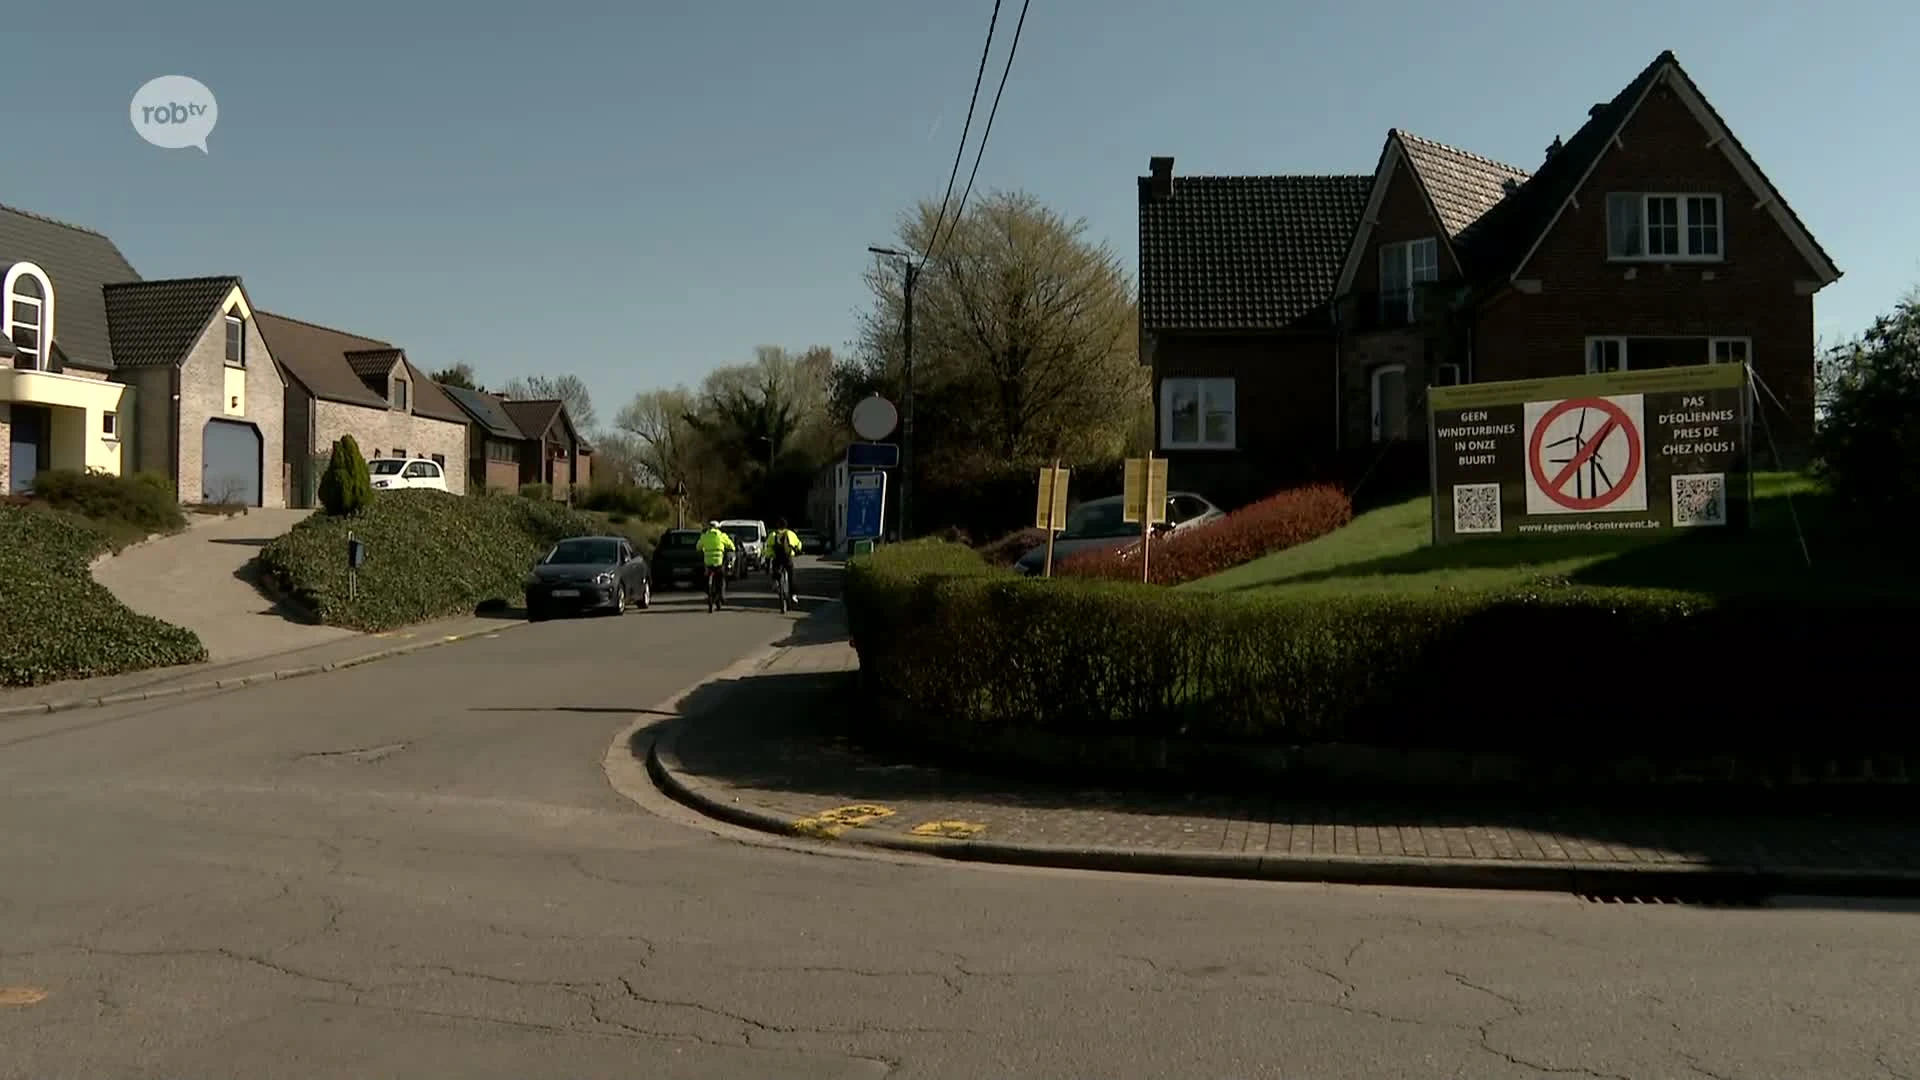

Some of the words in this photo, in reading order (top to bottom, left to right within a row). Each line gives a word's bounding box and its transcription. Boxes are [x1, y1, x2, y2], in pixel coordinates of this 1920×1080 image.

[1682, 396, 1705, 408] PAS
[1460, 411, 1488, 422] GEEN
[1437, 424, 1516, 438] WINDTURBINES
[1673, 427, 1702, 439] PRES
[1703, 426, 1719, 437] DE
[1454, 441, 1466, 451] IN
[1468, 439, 1497, 451] ONZE
[1662, 443, 1692, 456] CHEZ
[1694, 442, 1729, 454] NOUS
[1458, 454, 1496, 465] BUURT!
[1518, 519, 1661, 533] www.tegenwind-contrevent.be
